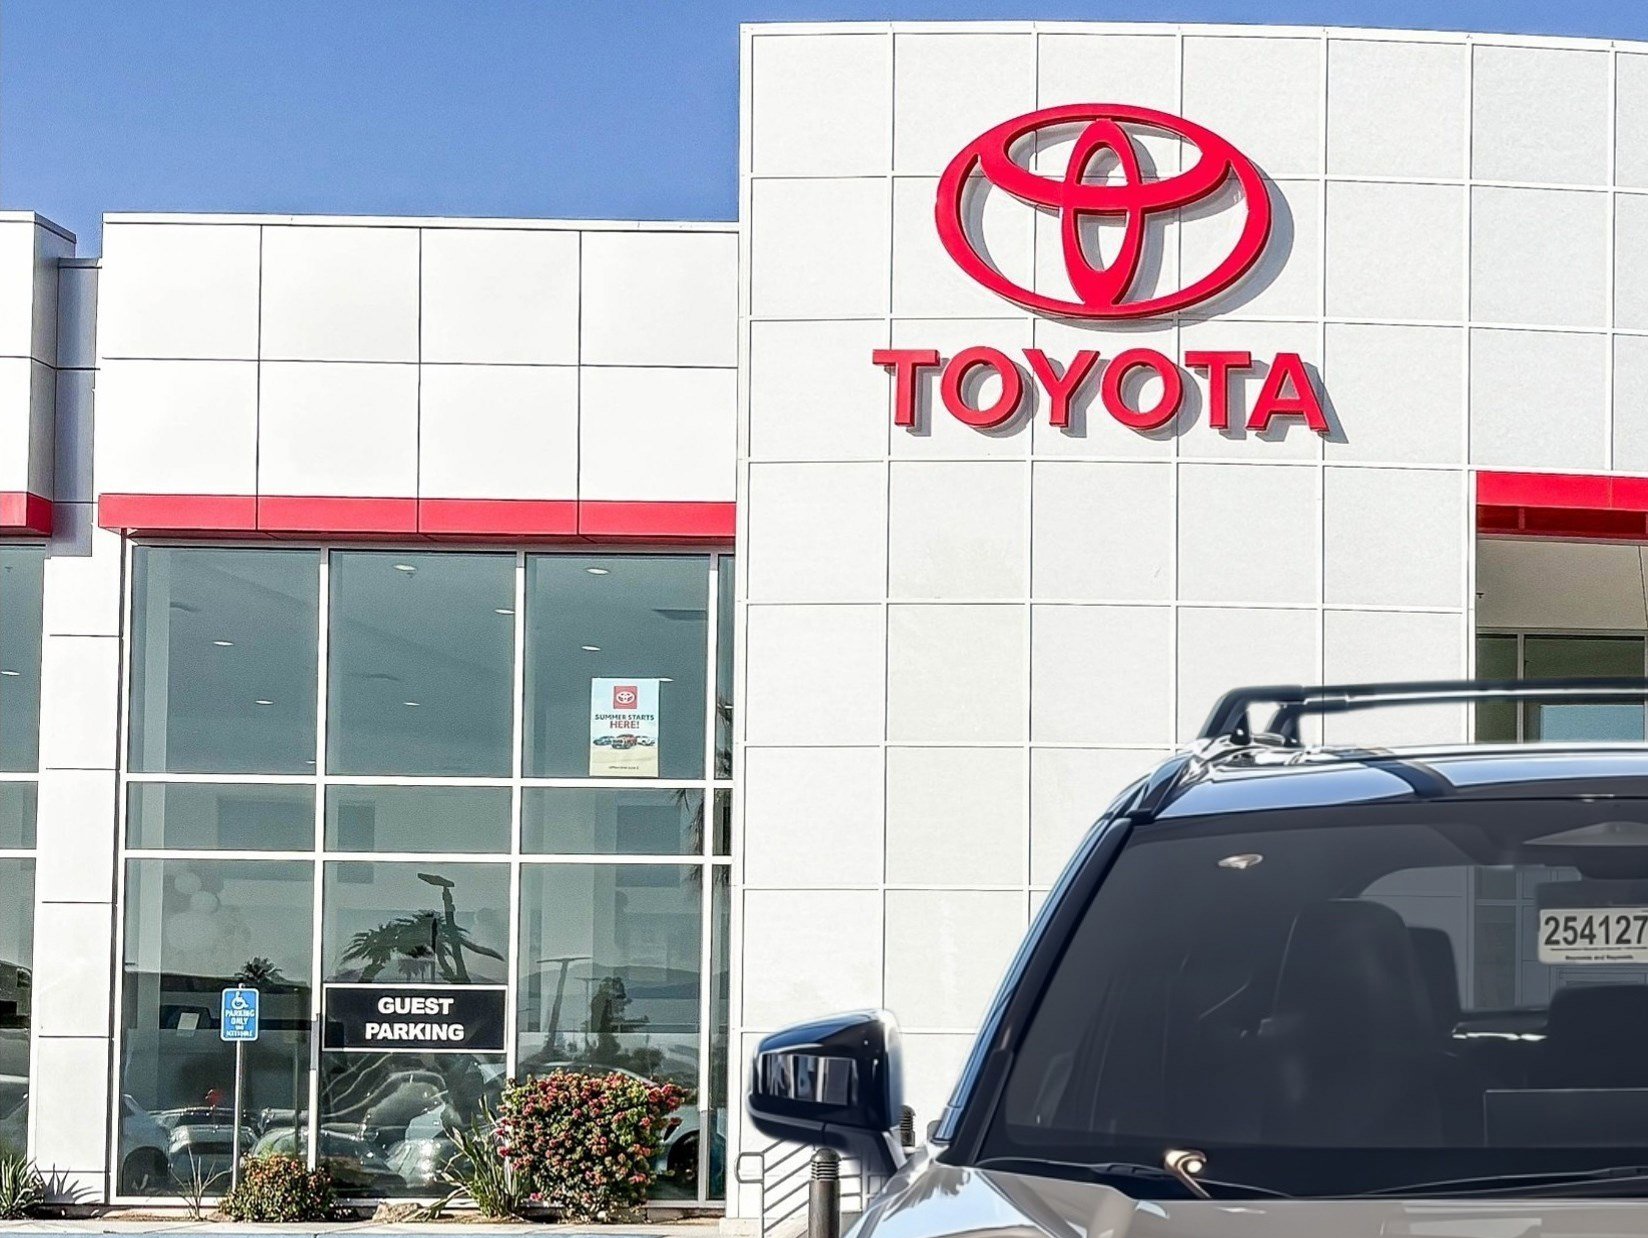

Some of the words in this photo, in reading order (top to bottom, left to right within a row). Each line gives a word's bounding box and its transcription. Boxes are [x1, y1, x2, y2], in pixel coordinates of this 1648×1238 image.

[872, 346, 1330, 432] TOYOTA
[609, 720, 640, 729] HERE!
[1544, 915, 1648, 946] 254127
[225, 1009, 255, 1017] PARKING
[377, 997, 455, 1015] GUEST
[230, 1017, 248, 1025] ONLY
[365, 1022, 465, 1041] PARKING
